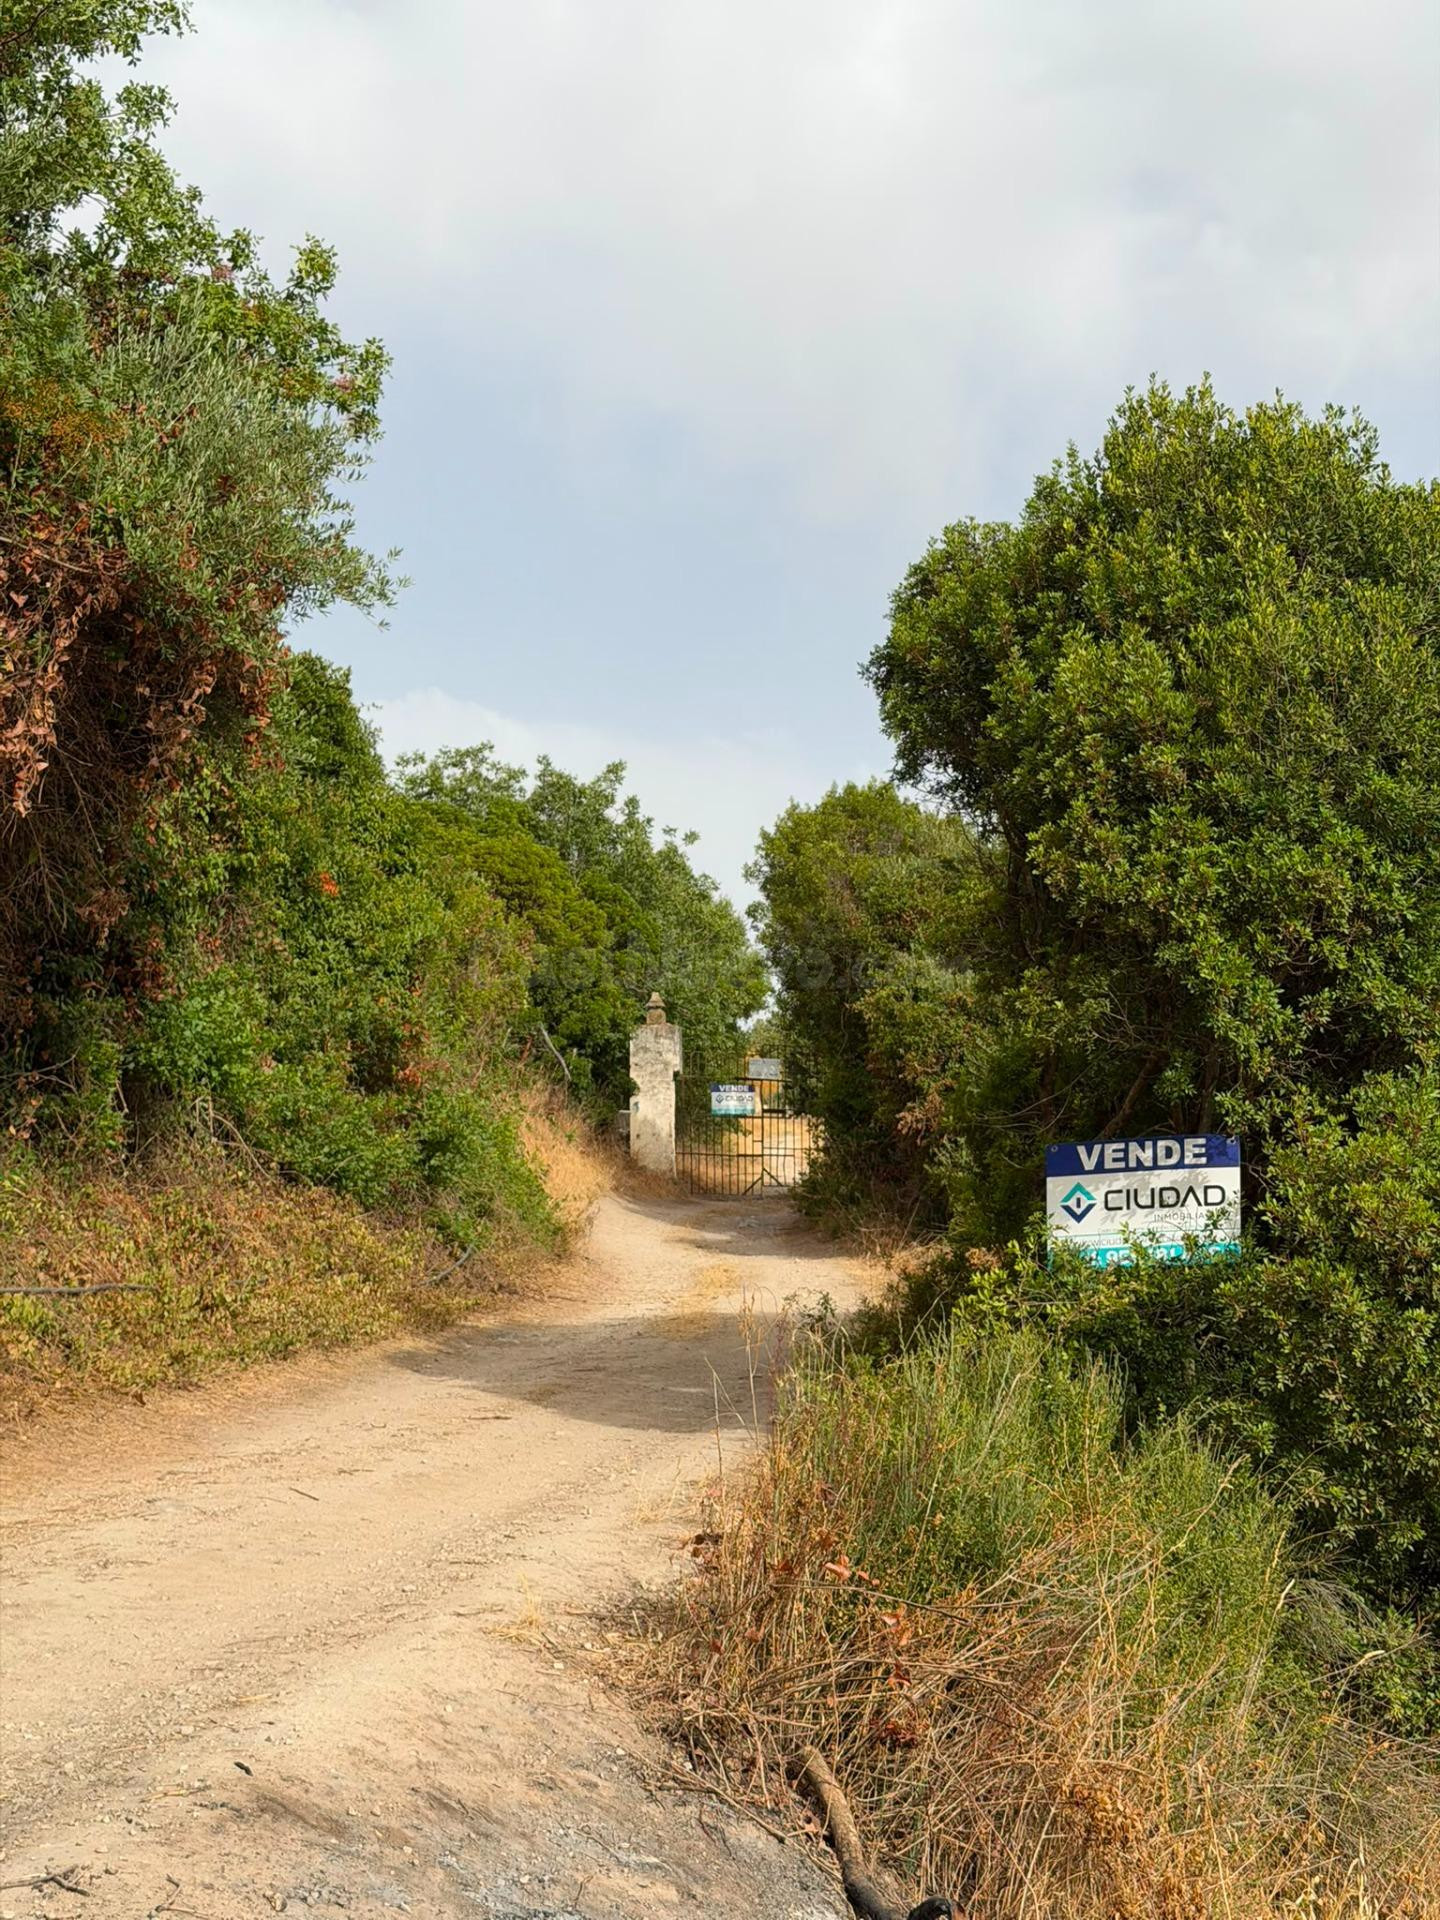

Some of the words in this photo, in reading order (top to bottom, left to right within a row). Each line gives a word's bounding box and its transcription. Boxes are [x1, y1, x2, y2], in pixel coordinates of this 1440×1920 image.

[719, 1084, 749, 1092] VENDE
[1076, 1137, 1208, 1171] VENDE
[1104, 1185, 1226, 1211] CIUDAD
